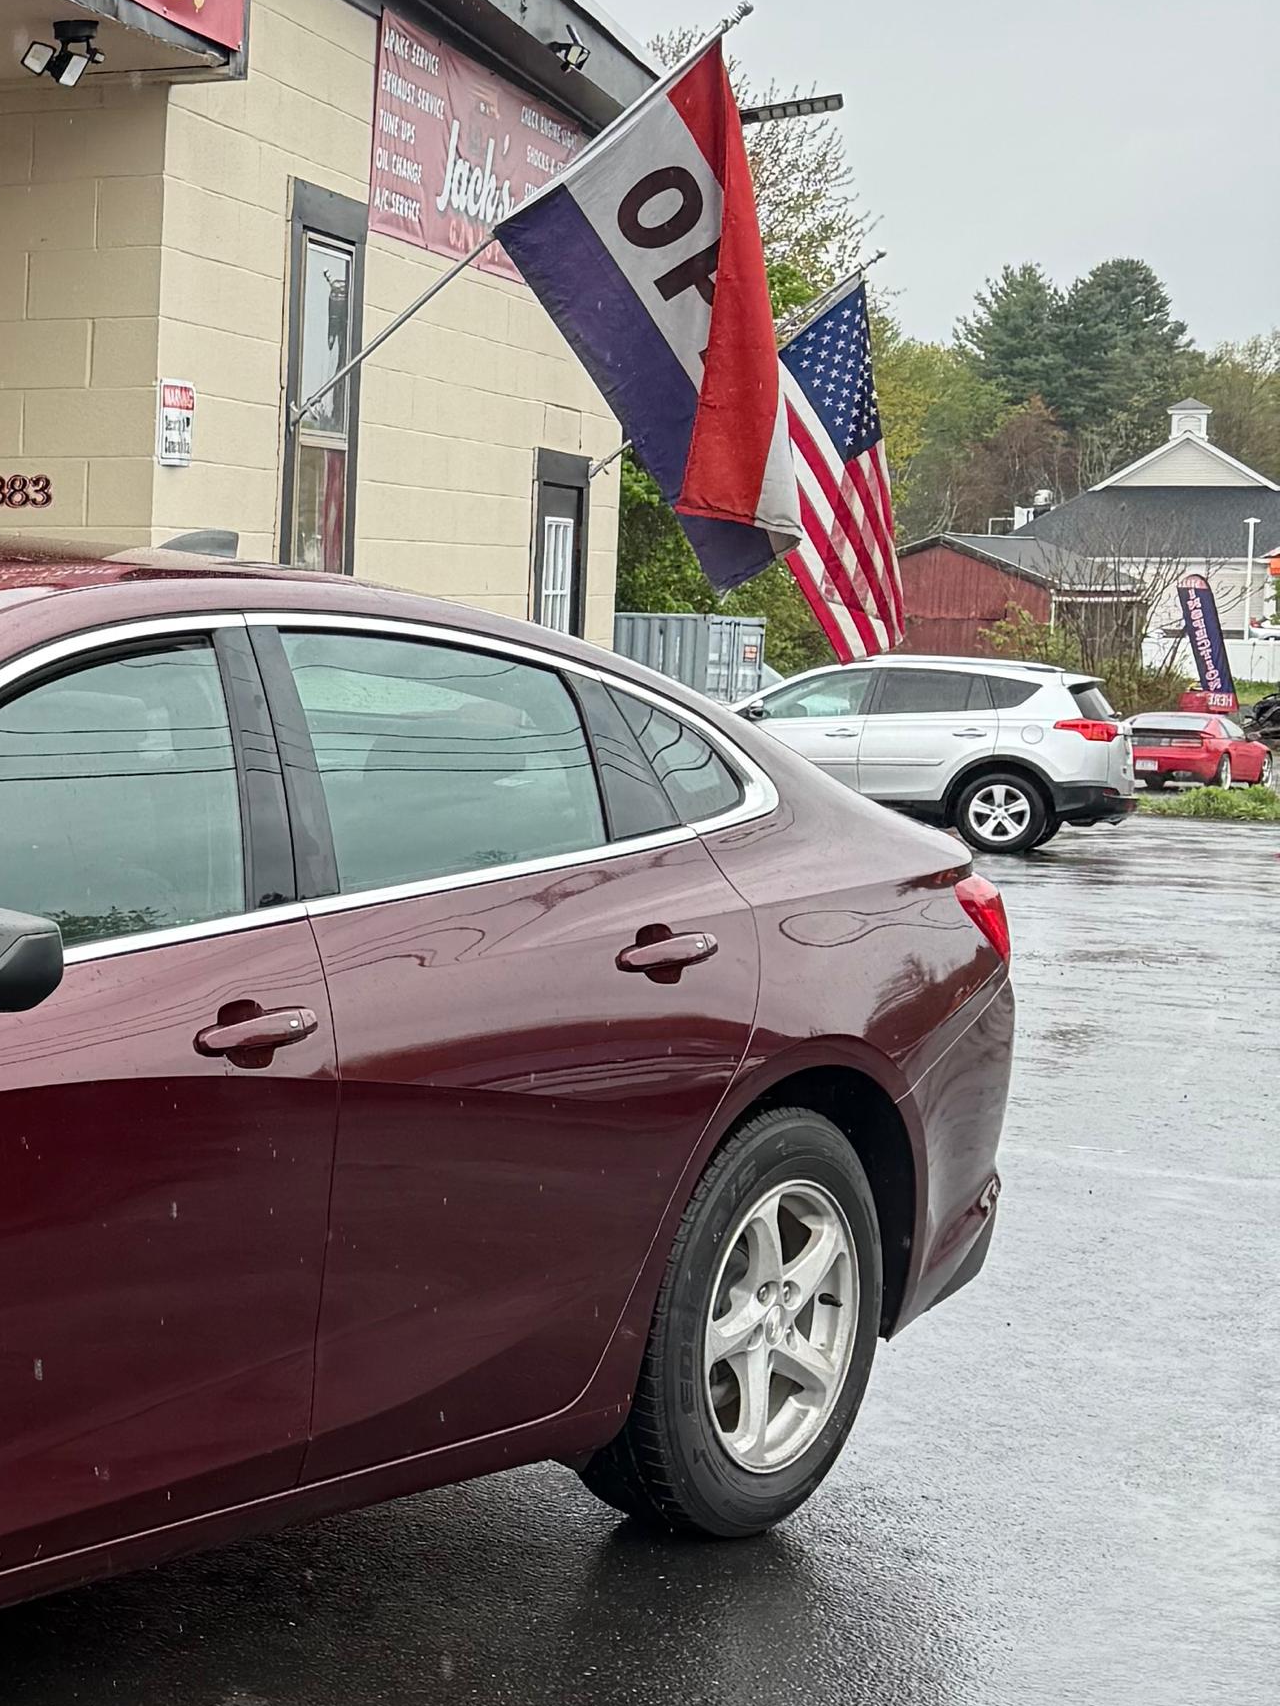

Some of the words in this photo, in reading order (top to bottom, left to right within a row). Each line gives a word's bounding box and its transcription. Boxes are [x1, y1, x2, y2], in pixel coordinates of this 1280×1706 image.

[411, 44, 439, 76] SERVICE
[381, 69, 415, 105] EXHAUST
[417, 88, 445, 120] SERVICE
[378, 109, 400, 137] TUNE
[401, 120, 416, 144] UPS
[376, 147, 389, 171] OIL
[392, 154, 423, 185] CHANGE
[374, 186, 389, 212] A/C
[392, 192, 421, 223] SERVICE
